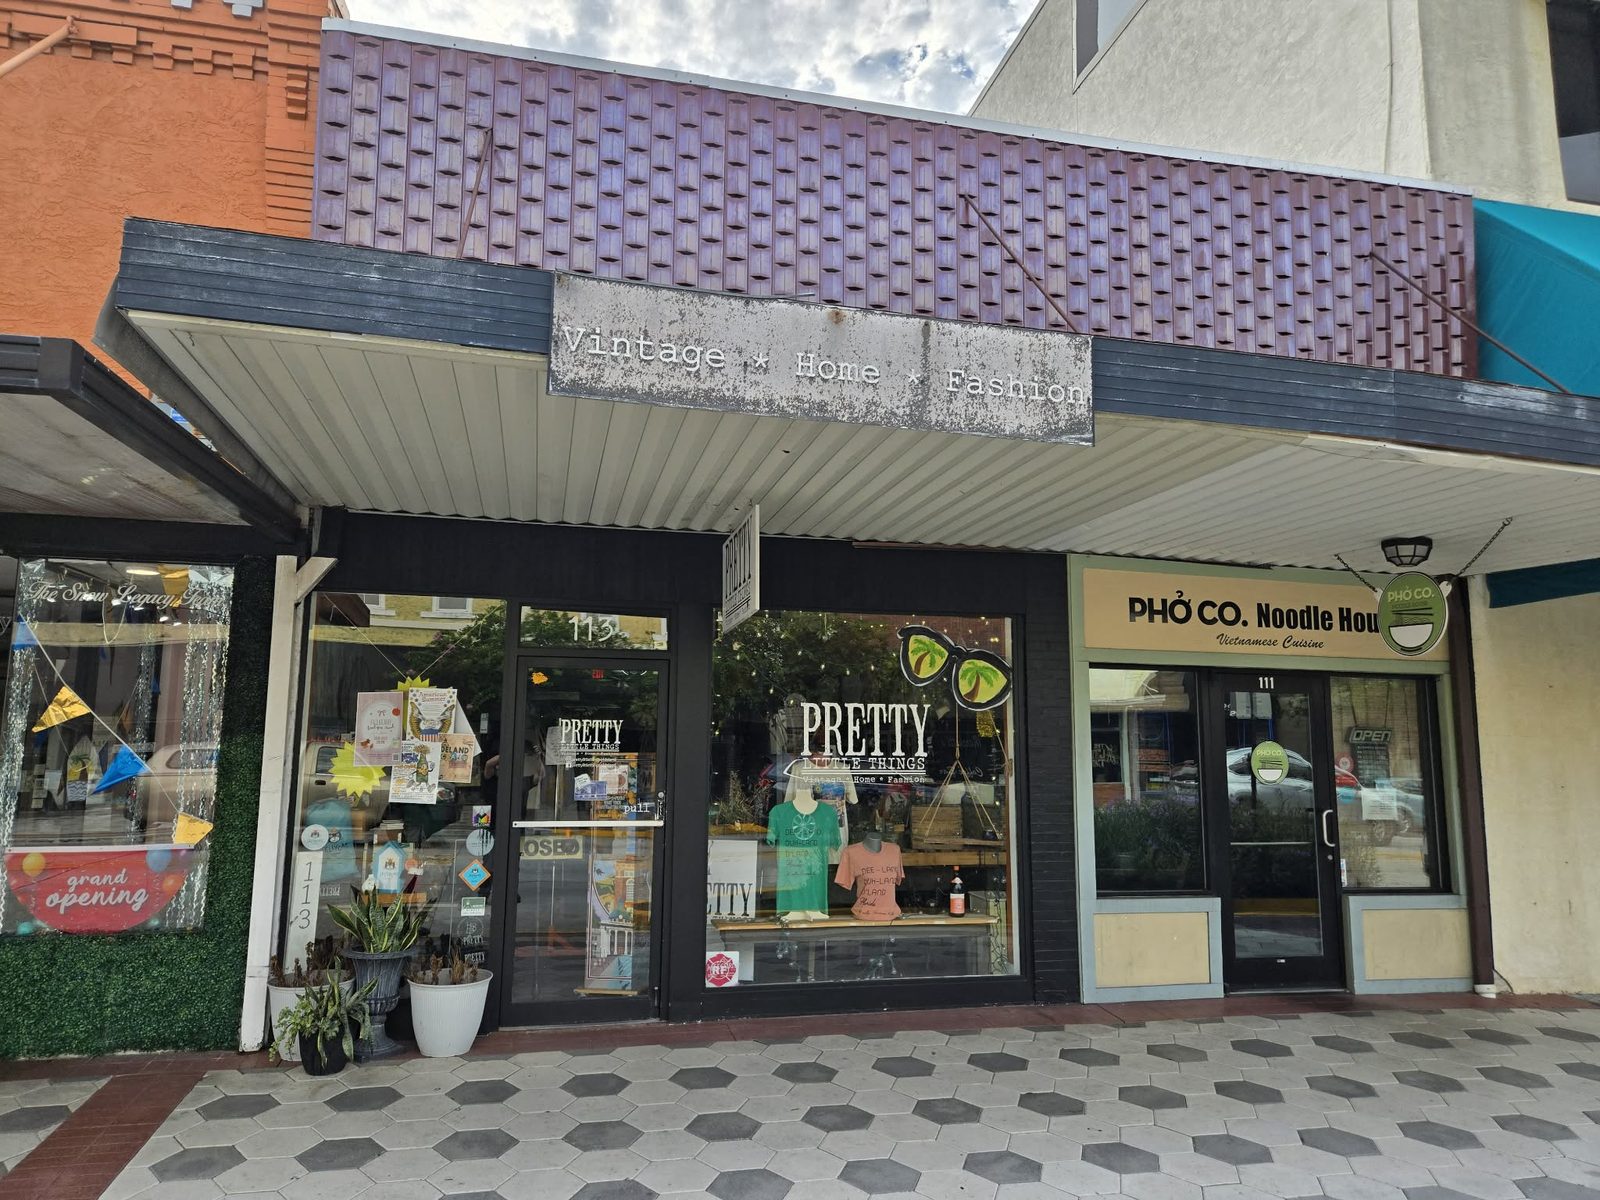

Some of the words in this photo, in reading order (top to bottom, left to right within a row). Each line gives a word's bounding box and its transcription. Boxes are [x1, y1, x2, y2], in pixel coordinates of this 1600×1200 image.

[562, 325, 726, 373] Vintage
[796, 353, 881, 384] Home
[946, 369, 1088, 405] Fashion
[27, 580, 58, 601] The
[117, 584, 173, 608] Legacy
[568, 615, 614, 642] 113
[1197, 601, 1249, 627] CO.
[1256, 602, 1334, 632] Noodle
[1338, 607, 1379, 634] Hou
[1216, 632, 1279, 647] Vietnamese
[1282, 634, 1325, 649] Cuisine
[1258, 676, 1274, 689] 111
[559, 718, 624, 744] PRETTY
[800, 701, 932, 758] PRETTY
[1353, 730, 1391, 741] OPEN
[803, 757, 861, 770] LITTLE
[868, 757, 926, 770] THINGS
[853, 775, 877, 784] Home
[887, 775, 925, 784] Fashion
[623, 803, 650, 814] pull
[523, 838, 580, 857] OSED
[67, 868, 128, 893] grand
[45, 886, 148, 914] opening
